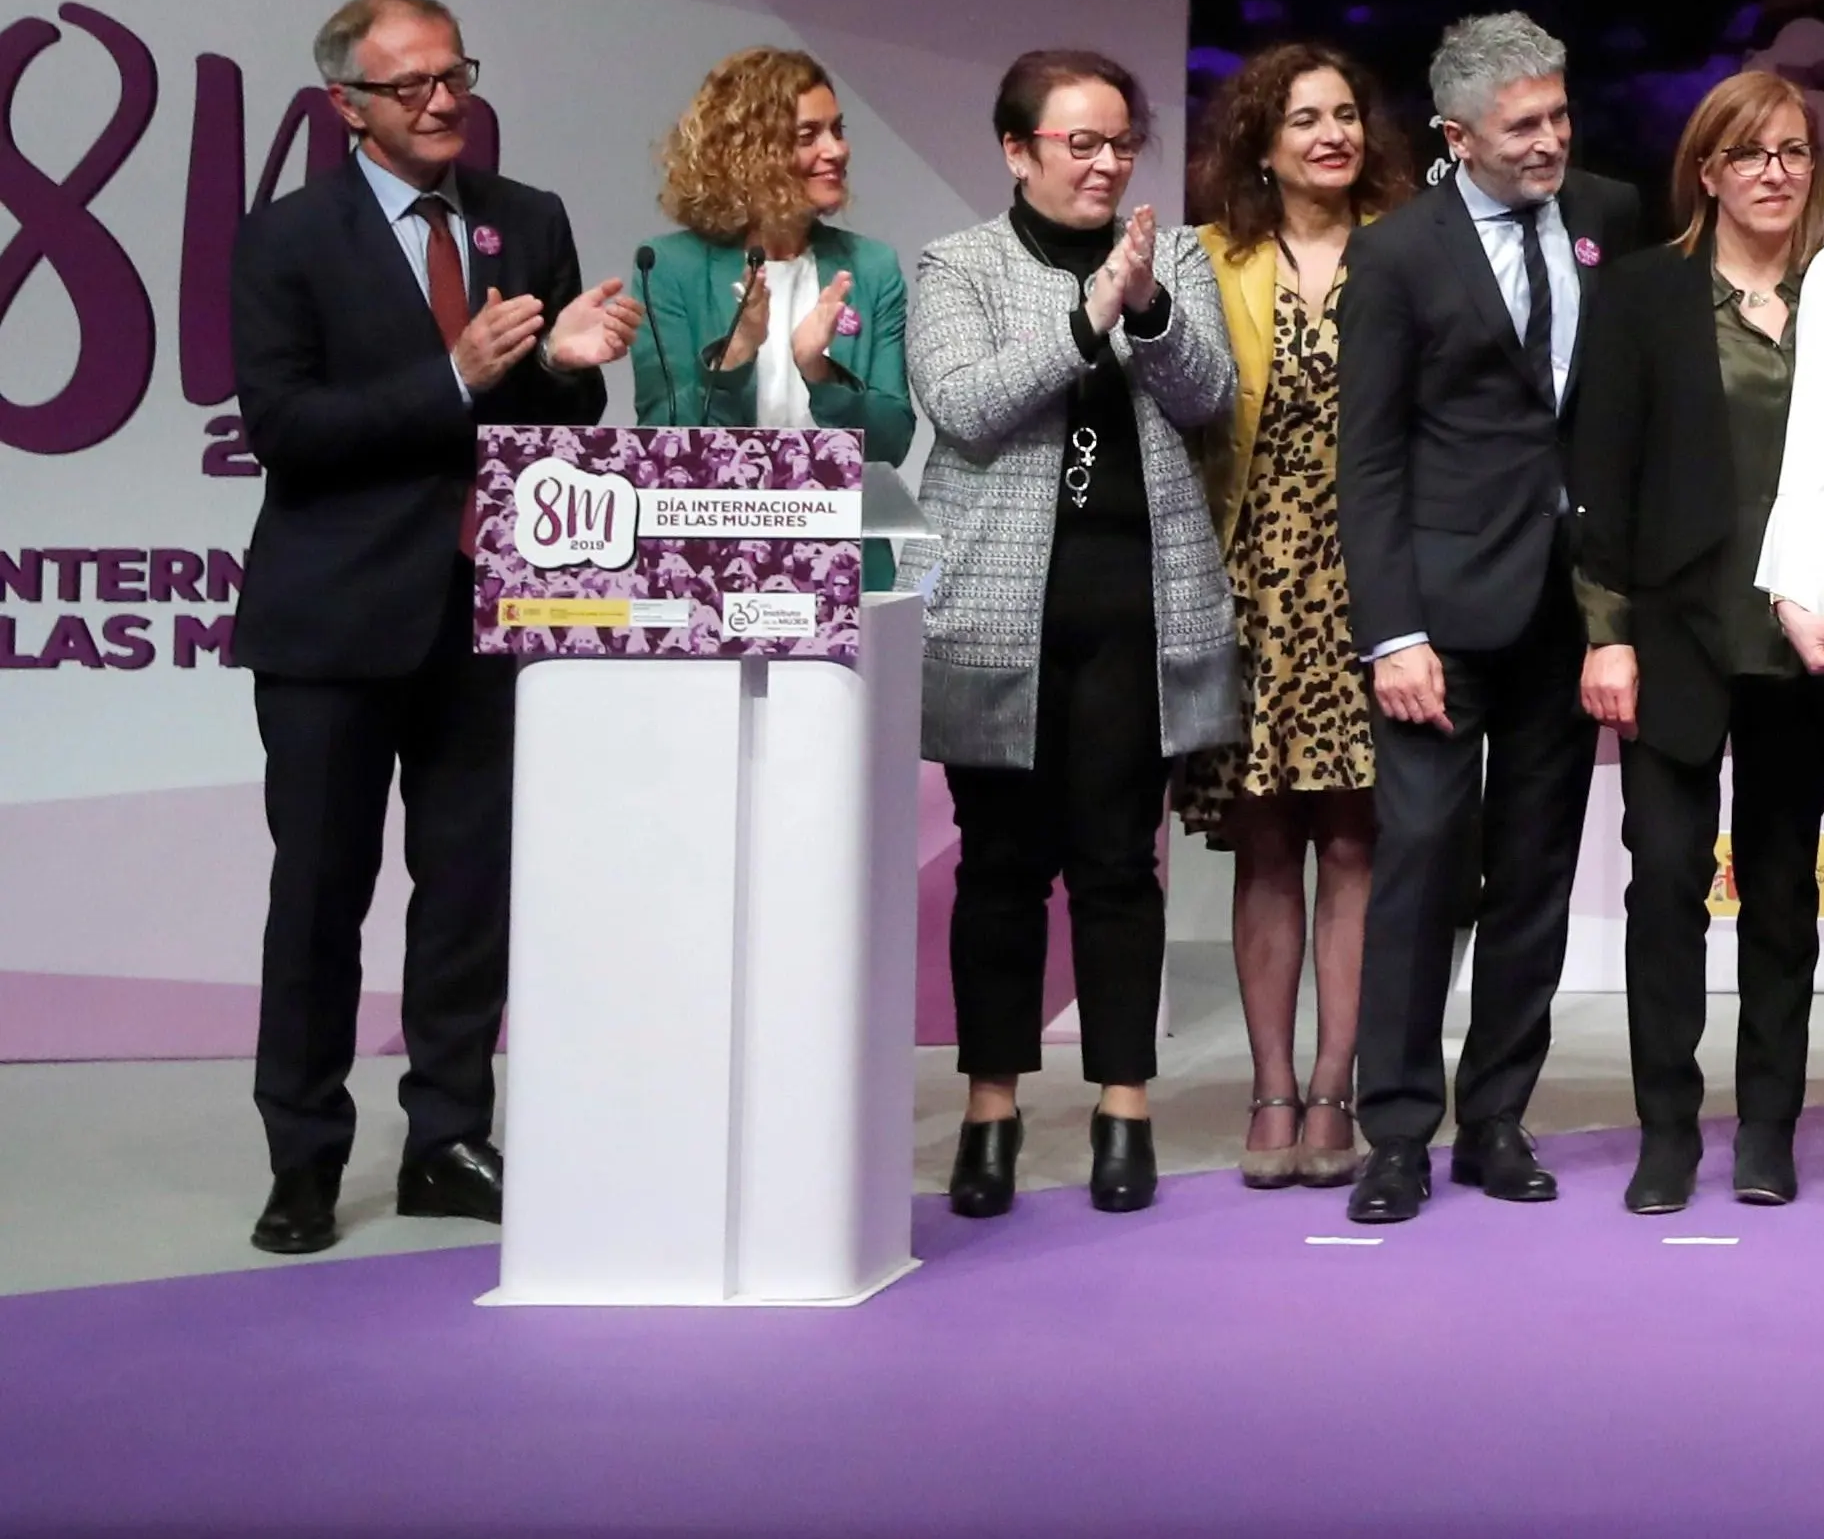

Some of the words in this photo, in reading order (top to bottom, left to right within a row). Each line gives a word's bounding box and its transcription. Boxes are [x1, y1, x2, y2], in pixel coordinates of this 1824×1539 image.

[532, 475, 616, 546] 8M
[656, 497, 688, 513] DÍA
[691, 500, 838, 514] INTERNACIONAL
[656, 514, 681, 527] DE
[683, 514, 718, 527] LAS
[722, 514, 808, 528] MUJERES
[569, 540, 606, 551] 2019
